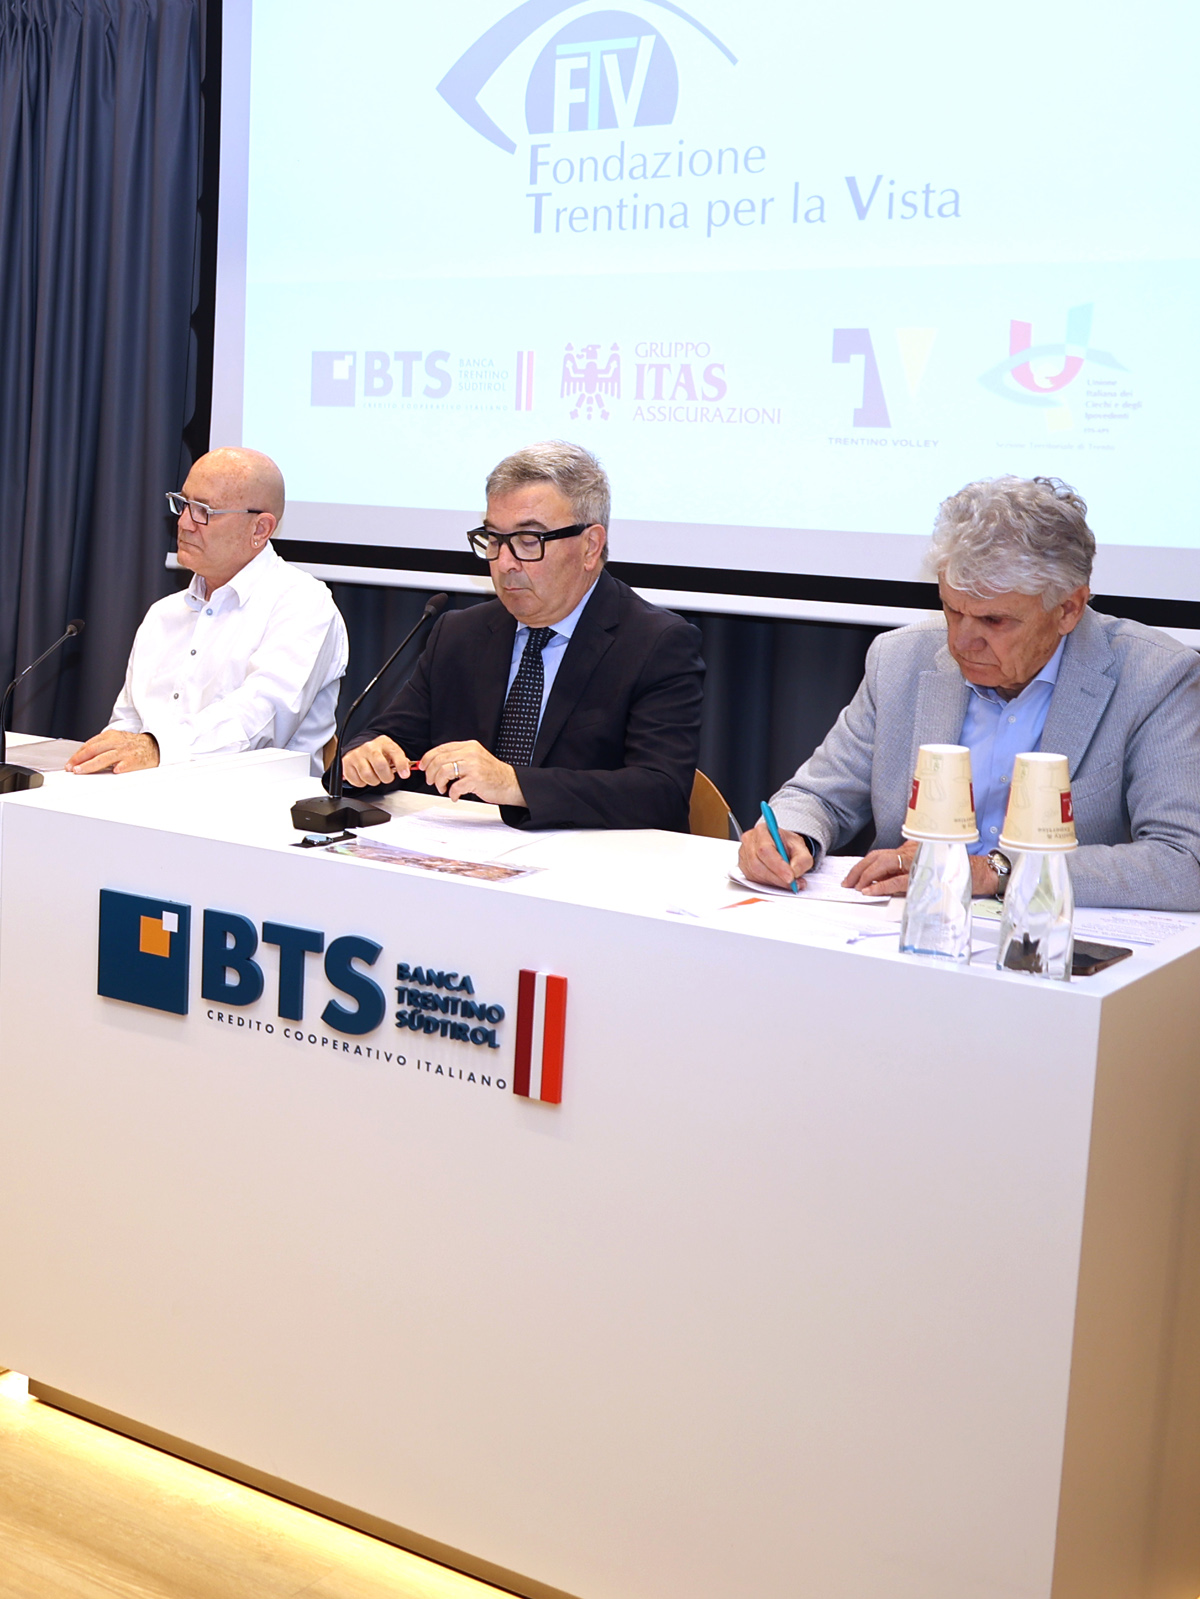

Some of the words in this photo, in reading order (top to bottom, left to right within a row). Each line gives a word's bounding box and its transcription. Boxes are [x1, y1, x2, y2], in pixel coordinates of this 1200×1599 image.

[553, 34, 657, 134] FTV
[529, 139, 767, 186] Fondazione
[525, 192, 690, 235] Trentina
[705, 194, 776, 239] per
[791, 181, 828, 225] la
[844, 174, 963, 222] Vista
[458, 358, 495, 369] BANCA
[634, 341, 711, 359] GRUPPO
[363, 350, 453, 400] BTS
[458, 369, 509, 380] TRENTINO
[633, 363, 729, 403] ITAS
[632, 405, 782, 425] ASSICURAZIONI
[828, 437, 888, 447] TRENTINO
[892, 439, 939, 448] VOLLEY
[201, 907, 387, 1036] BTS
[396, 961, 475, 996] BANCA
[395, 985, 506, 1025] TRENTINO
[206, 1008, 276, 1035] CREDITO
[283, 1027, 407, 1066] COOPERATIVO
[416, 1058, 508, 1091] ITALIANO
[395, 1009, 500, 1050] SÜDTIROL
